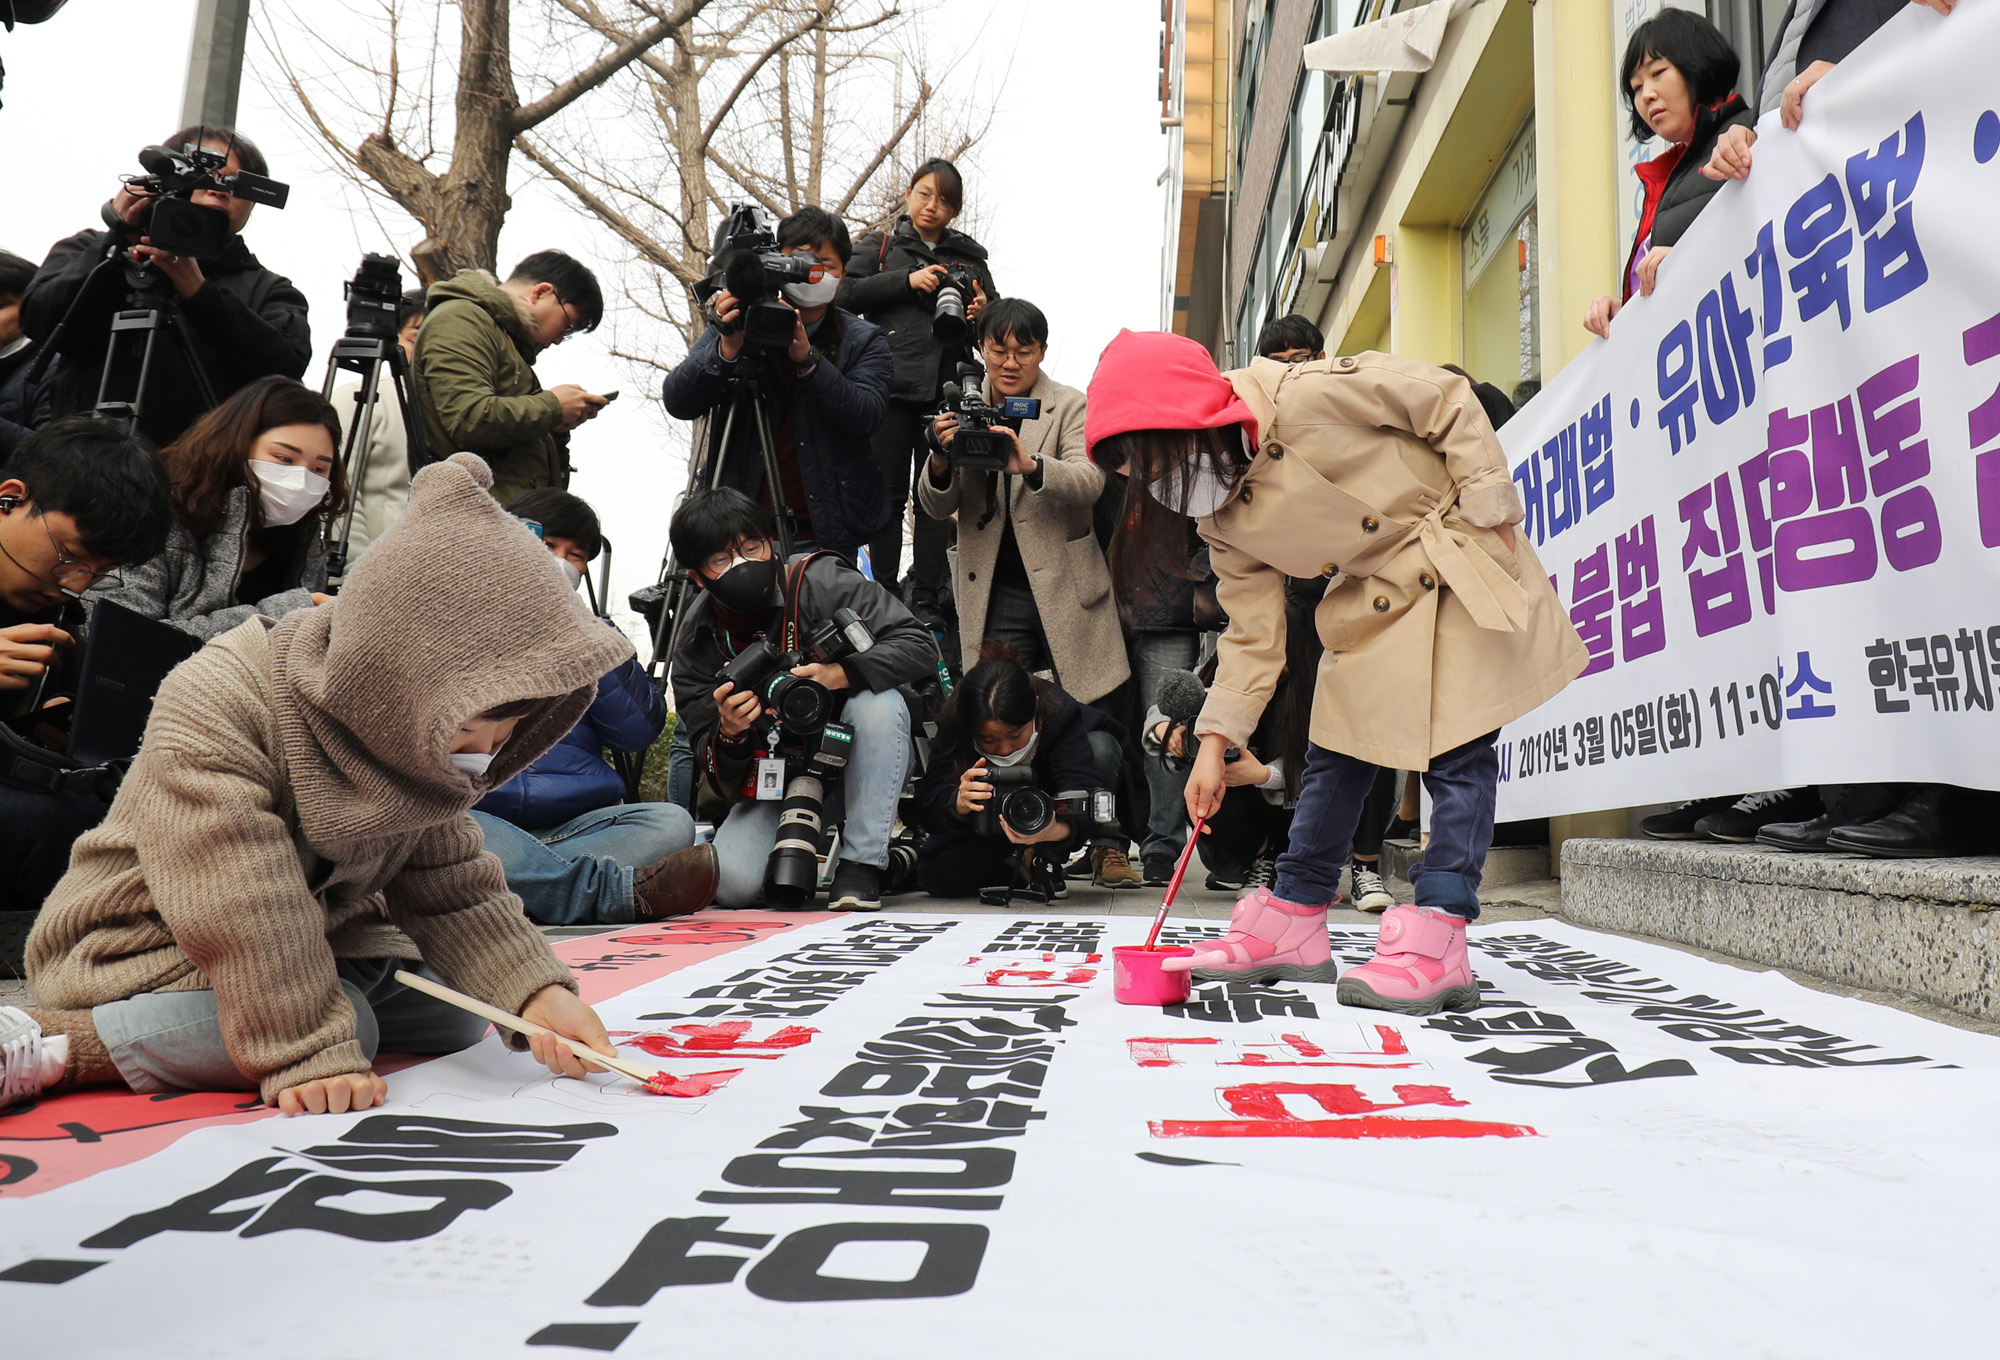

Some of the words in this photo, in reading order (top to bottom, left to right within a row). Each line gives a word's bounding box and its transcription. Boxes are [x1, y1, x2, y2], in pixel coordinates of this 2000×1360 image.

[1469, 208, 1489, 271] 소품
[1513, 392, 1614, 546] 거래법
[786, 621, 794, 653] Cano
[1571, 514, 1666, 680] 불법
[1492, 741, 1512, 784] 시
[1519, 725, 1569, 778] 2019년
[1573, 715, 1605, 767] 3월
[1610, 688, 1702, 760] 05일(화)
[1709, 673, 1781, 740] 11:0
[1777, 651, 1837, 720] 소
